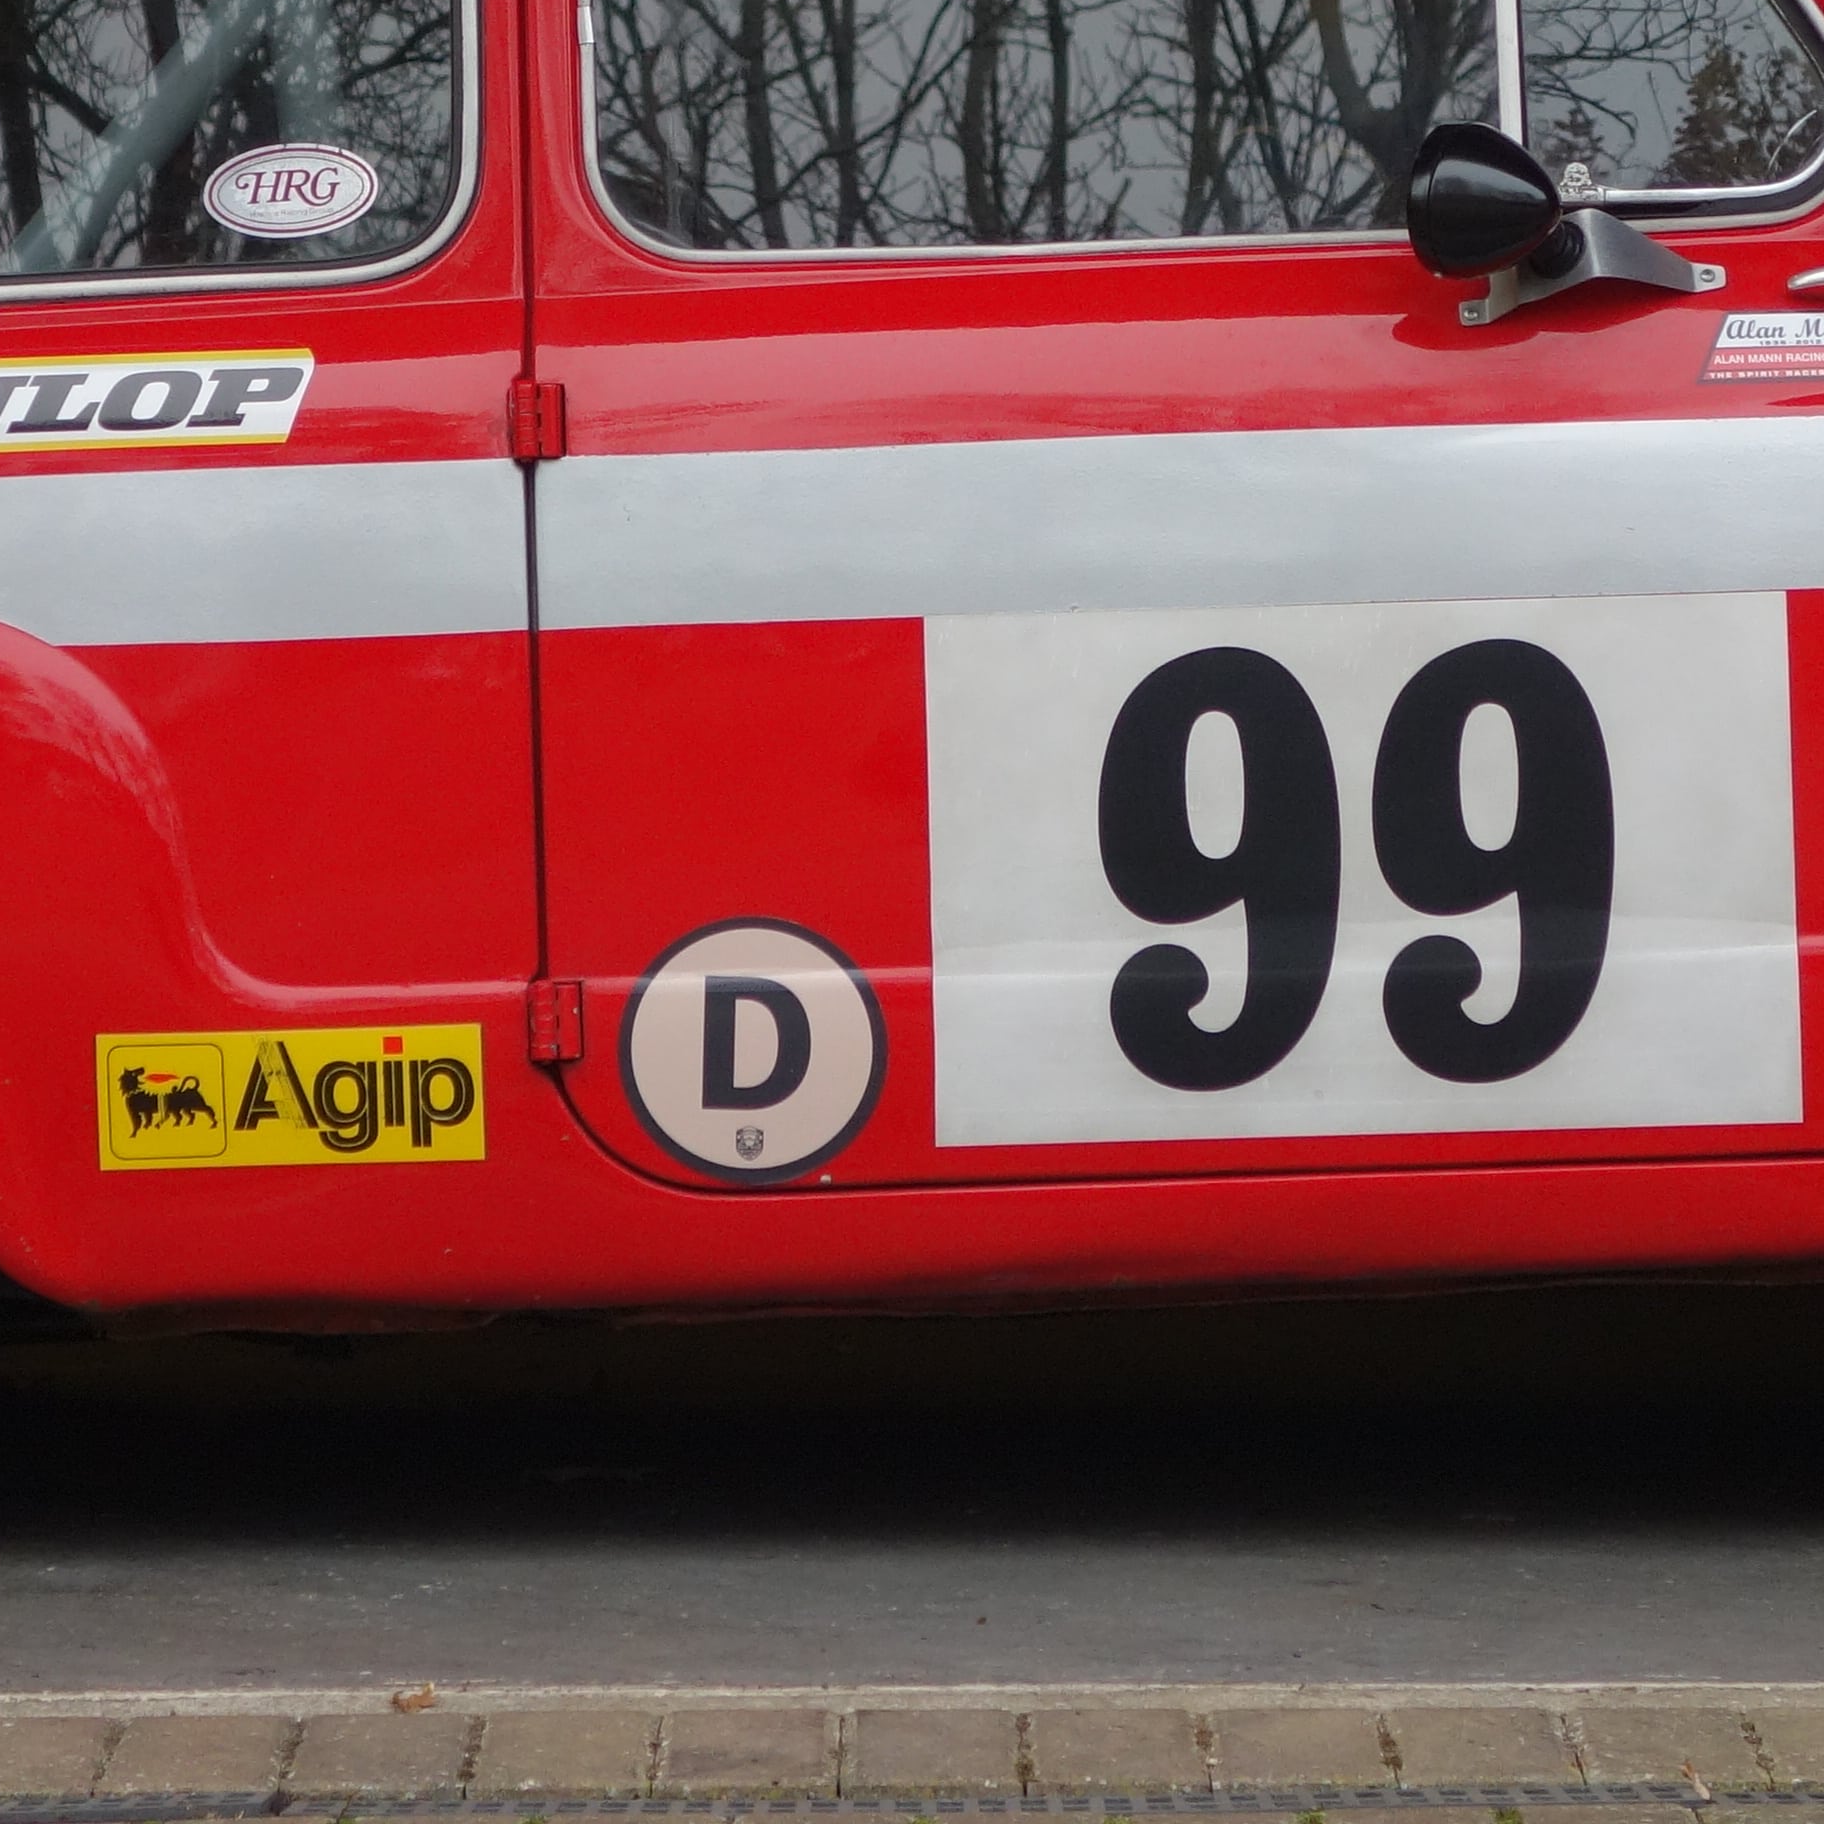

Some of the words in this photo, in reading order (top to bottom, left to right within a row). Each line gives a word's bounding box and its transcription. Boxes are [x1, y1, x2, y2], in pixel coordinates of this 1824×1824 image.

[235, 166, 342, 208] HRG
[1726, 317, 1787, 340] Alan
[1709, 371, 1734, 380] THE
[1714, 354, 1746, 366] ALAN
[1748, 353, 1782, 365] MANN
[1097, 637, 1616, 1093] 99
[702, 975, 812, 1110] D
[233, 1035, 475, 1154] Agip
